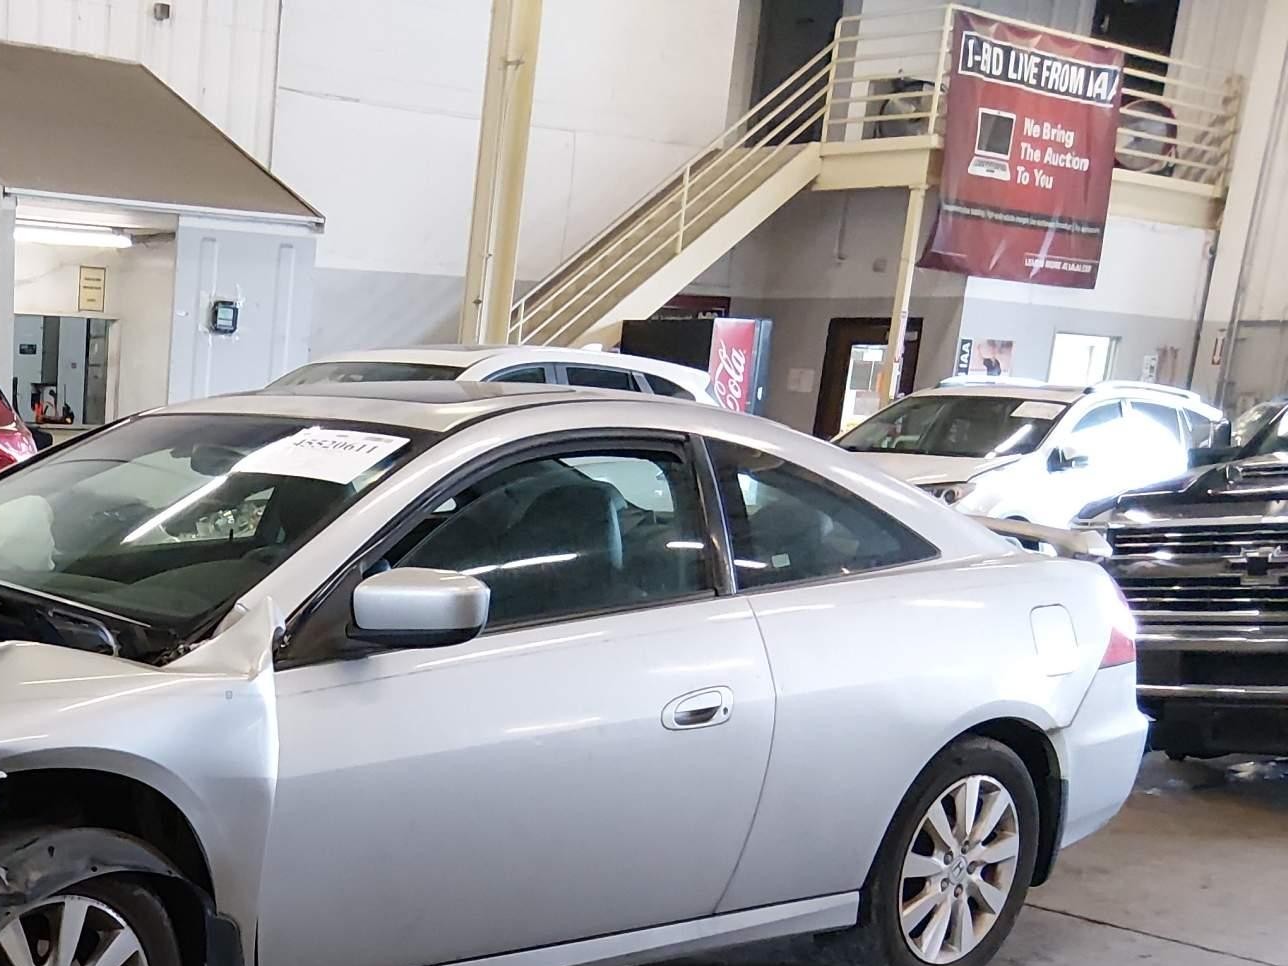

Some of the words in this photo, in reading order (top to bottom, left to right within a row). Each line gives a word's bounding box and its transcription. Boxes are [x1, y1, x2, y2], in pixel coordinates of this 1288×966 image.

[1007, 49, 1040, 85] LIVE
[1040, 59, 1086, 96] FROM
[1042, 122, 1075, 148] Bring
[1020, 142, 1041, 163] The
[1043, 147, 1090, 172] Auction
[1016, 166, 1030, 185] To
[1034, 168, 1054, 189] You
[959, 342, 971, 368] IAA
[714, 339, 746, 412] Cola
